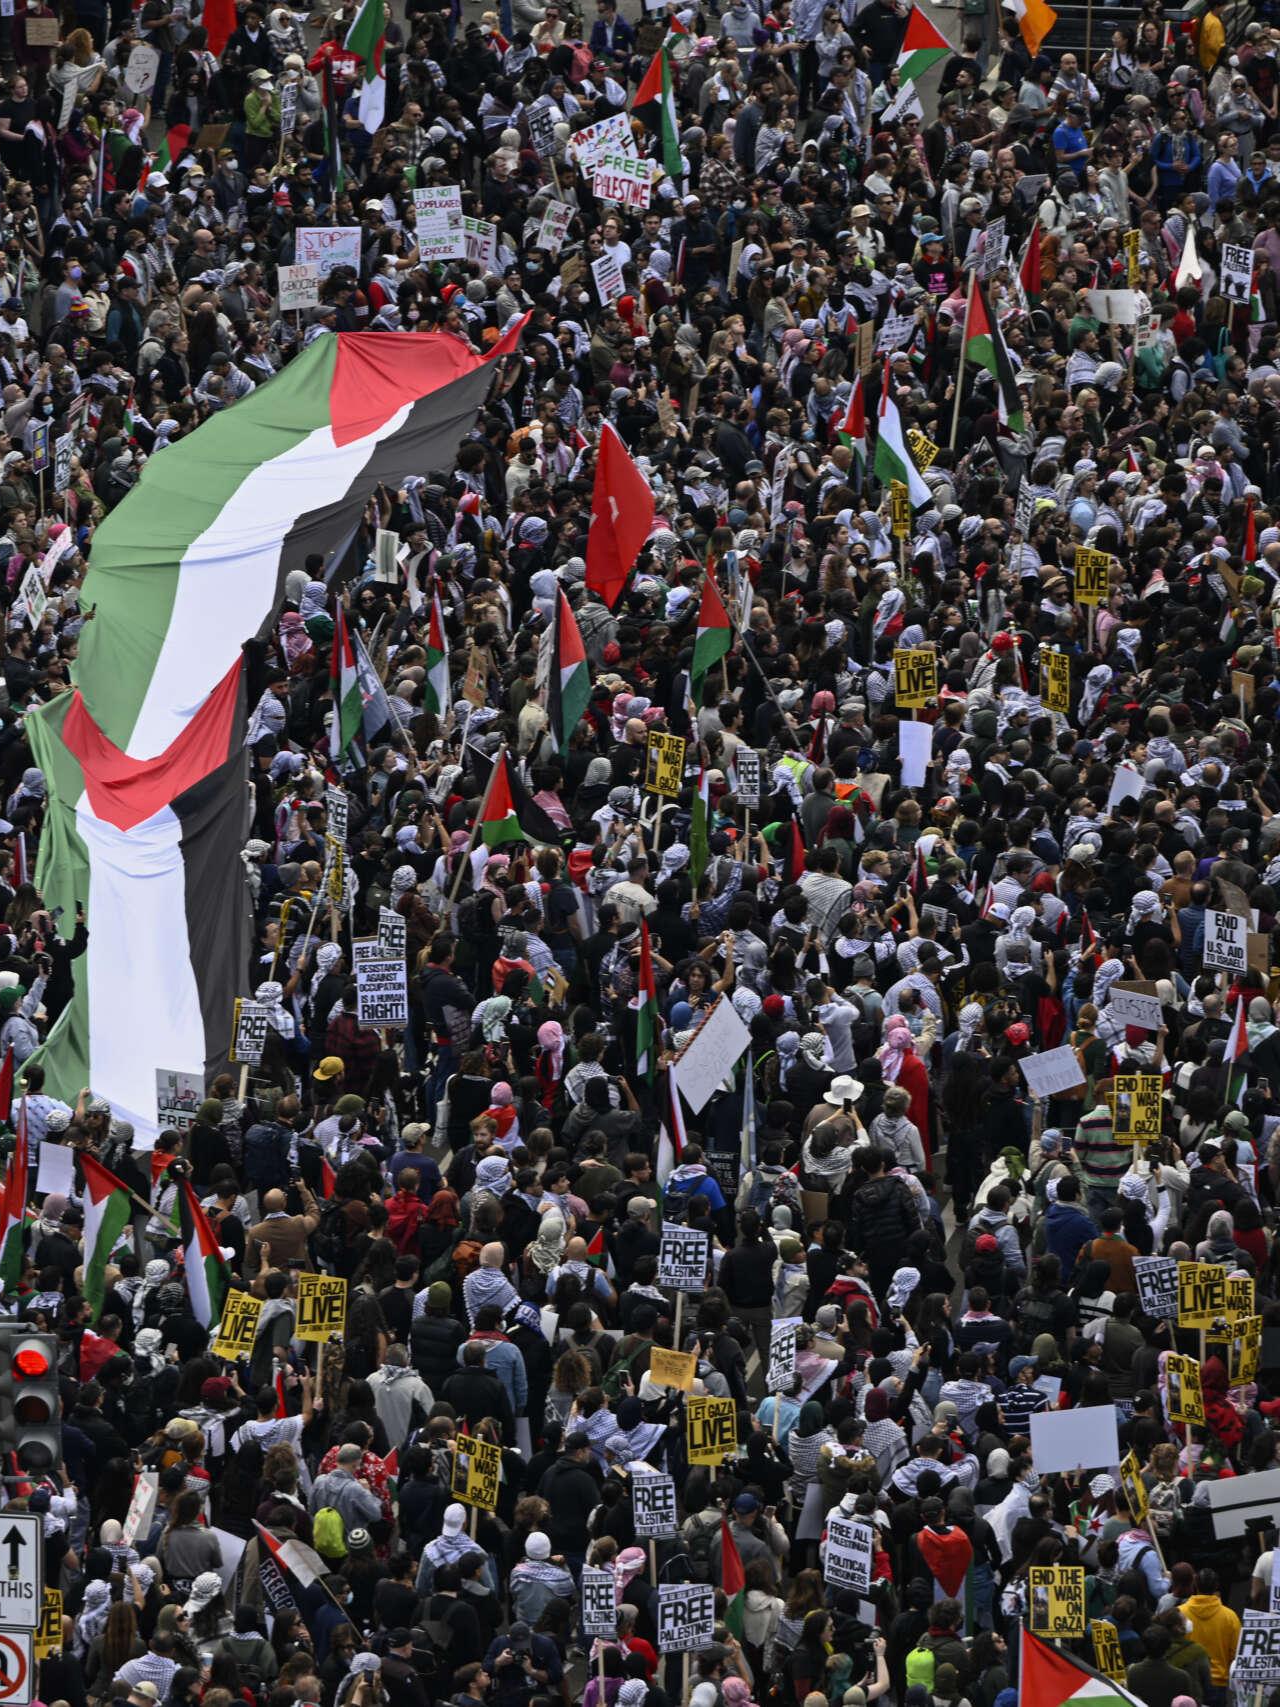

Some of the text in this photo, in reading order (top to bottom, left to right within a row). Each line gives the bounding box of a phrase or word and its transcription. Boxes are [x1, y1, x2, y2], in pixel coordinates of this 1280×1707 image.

[604, 154, 650, 180] FREE
[595, 173, 649, 208] PALESTINE
[304, 232, 342, 250] STOP
[1226, 246, 1251, 265] FREE
[289, 267, 308, 279] NO
[1076, 567, 1109, 590] LIVE!
[896, 653, 934, 670] LET GAZA
[896, 668, 936, 695] LIVE!
[650, 733, 683, 754] END THE
[662, 750, 680, 766] WAR
[669, 766, 680, 779] ON
[659, 776, 679, 791] GAZA
[1215, 913, 1238, 931] END
[380, 923, 407, 949] FREE
[1216, 929, 1236, 944] ALL
[1206, 953, 1215, 962] TO
[1207, 941, 1244, 959] U.S. AID
[359, 963, 404, 973] RESISTANCE
[366, 972, 398, 982] AGAINST
[359, 982, 405, 993] OCCUPATION
[377, 993, 405, 1003] HUMAN
[361, 1003, 405, 1020] RIGHT!
[240, 1015, 268, 1040] FREE
[1116, 1077, 1161, 1092] END THE
[1136, 1093, 1159, 1106] WAR
[1145, 1107, 1159, 1120] ON
[1134, 1120, 1160, 1133] GAZA
[661, 1239, 707, 1265] FREE
[660, 1264, 704, 1280] PALESTINE
[1180, 1268, 1224, 1286] LET GAZA
[300, 1281, 344, 1297] LET GAZA
[1139, 1268, 1177, 1298] FREE
[1230, 1280, 1252, 1296] THE
[1142, 1293, 1177, 1308] PALESTIN
[1181, 1281, 1226, 1314] LIVE!
[1226, 1296, 1252, 1311] WAR
[226, 1300, 259, 1315] LET GAZA
[299, 1295, 344, 1324] LIVE!
[219, 1314, 258, 1343] LIVE!
[690, 1401, 733, 1421] LET GAZA
[690, 1415, 735, 1449] LIVE!
[457, 1436, 499, 1459] END THE
[475, 1458, 498, 1477] WAR
[482, 1476, 496, 1489] ON
[471, 1487, 495, 1504] GAZA
[634, 1485, 674, 1512] FREE
[831, 1522, 870, 1544] FREE ALL
[829, 1534, 870, 1553] PALESTINIAN
[829, 1553, 867, 1575] POLITICAL
[1032, 1569, 1081, 1586] END THE
[0, 1580, 34, 1600] THIS
[584, 1584, 614, 1610] FREE
[1054, 1586, 1081, 1602] WAR
[660, 1594, 713, 1630] FREE
[1066, 1602, 1082, 1616] ON
[659, 1621, 712, 1643] PALESTINE
[1053, 1616, 1082, 1631] GAZA
[1238, 1628, 1280, 1656] FRE
[1236, 1656, 1280, 1670] PALESTIN
